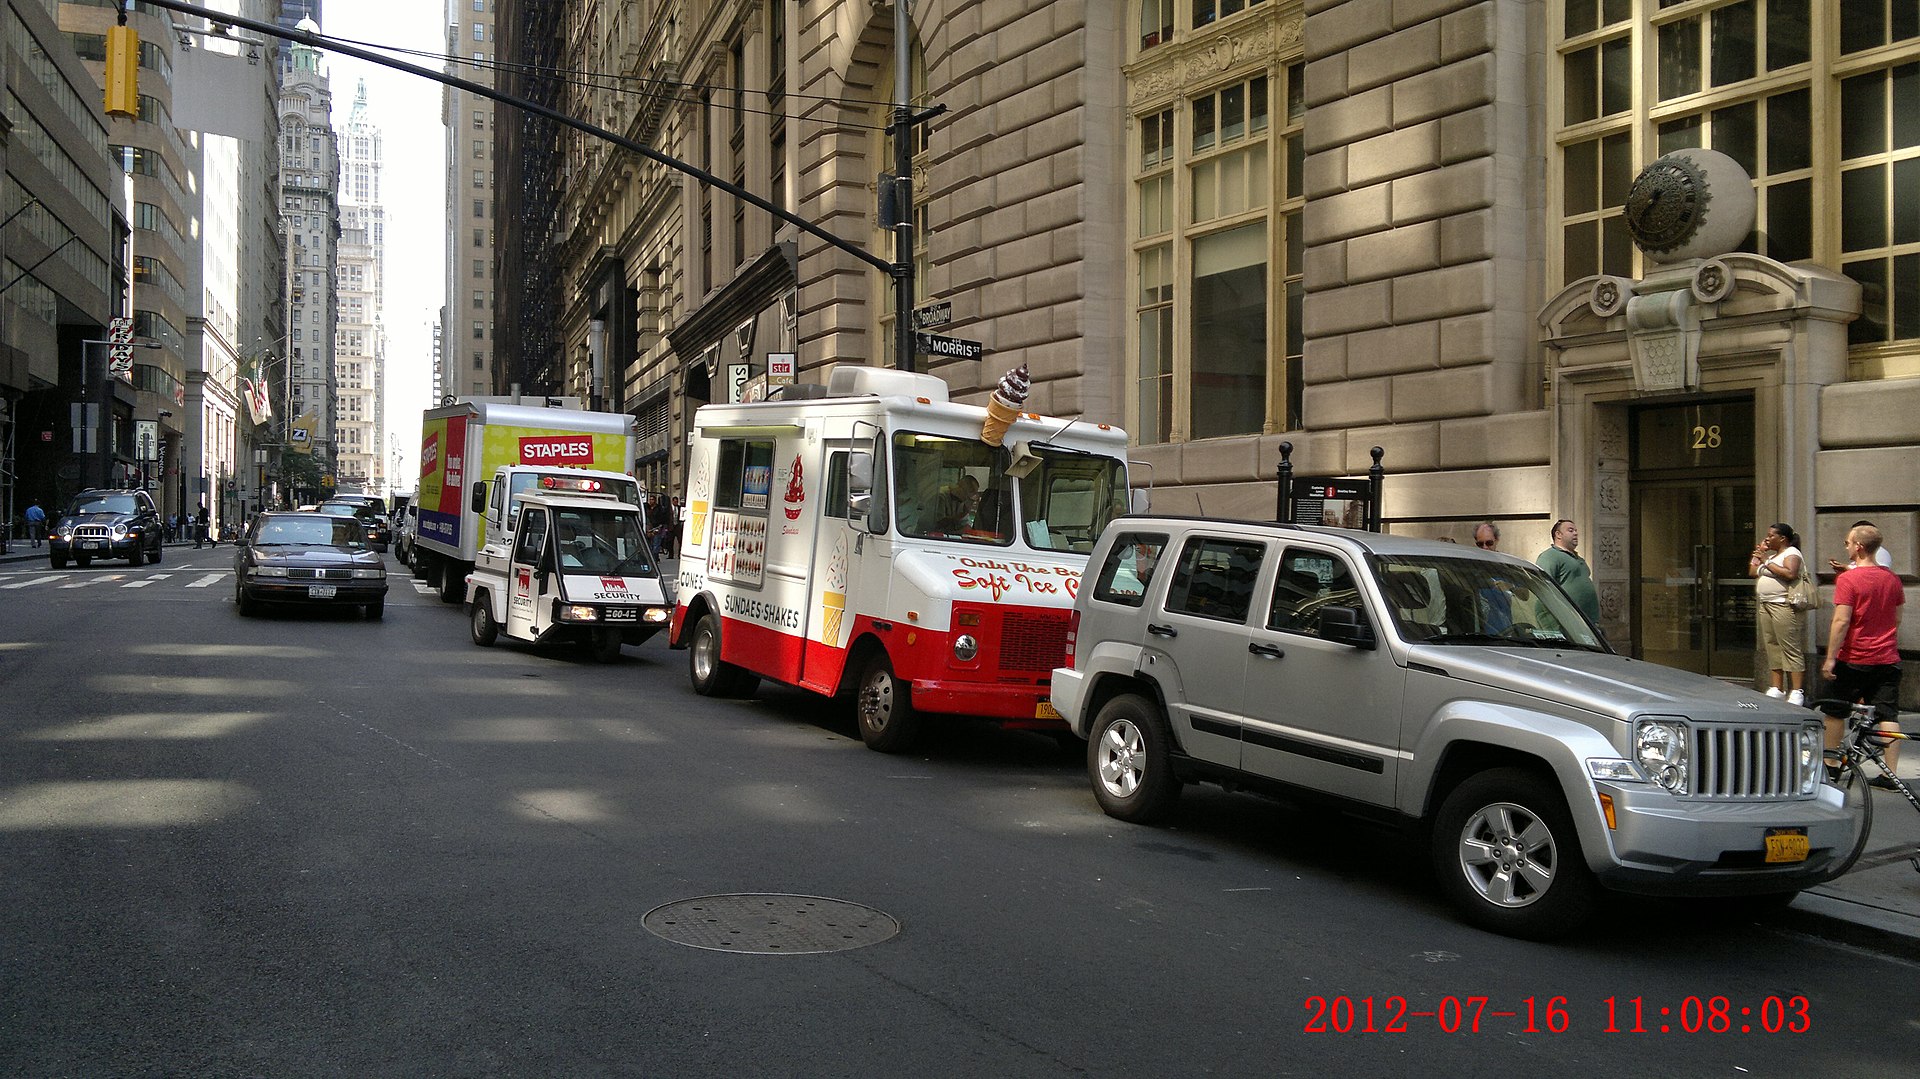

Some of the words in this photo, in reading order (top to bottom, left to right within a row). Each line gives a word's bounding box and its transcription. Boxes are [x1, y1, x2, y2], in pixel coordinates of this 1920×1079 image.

[922, 307, 951, 326] BROADWAY
[933, 340, 972, 357] MORRIS
[773, 364, 789, 373] stir
[1692, 425, 1721, 448] 28
[523, 442, 590, 458] STAPLES
[1010, 562, 1050, 575] The
[680, 570, 704, 590] CONES
[952, 569, 1010, 602] Soft
[1014, 573, 1058, 594] Ice
[513, 596, 532, 607] SECURITY
[593, 592, 641, 601] SECURITY
[612, 610, 630, 618] GO-4
